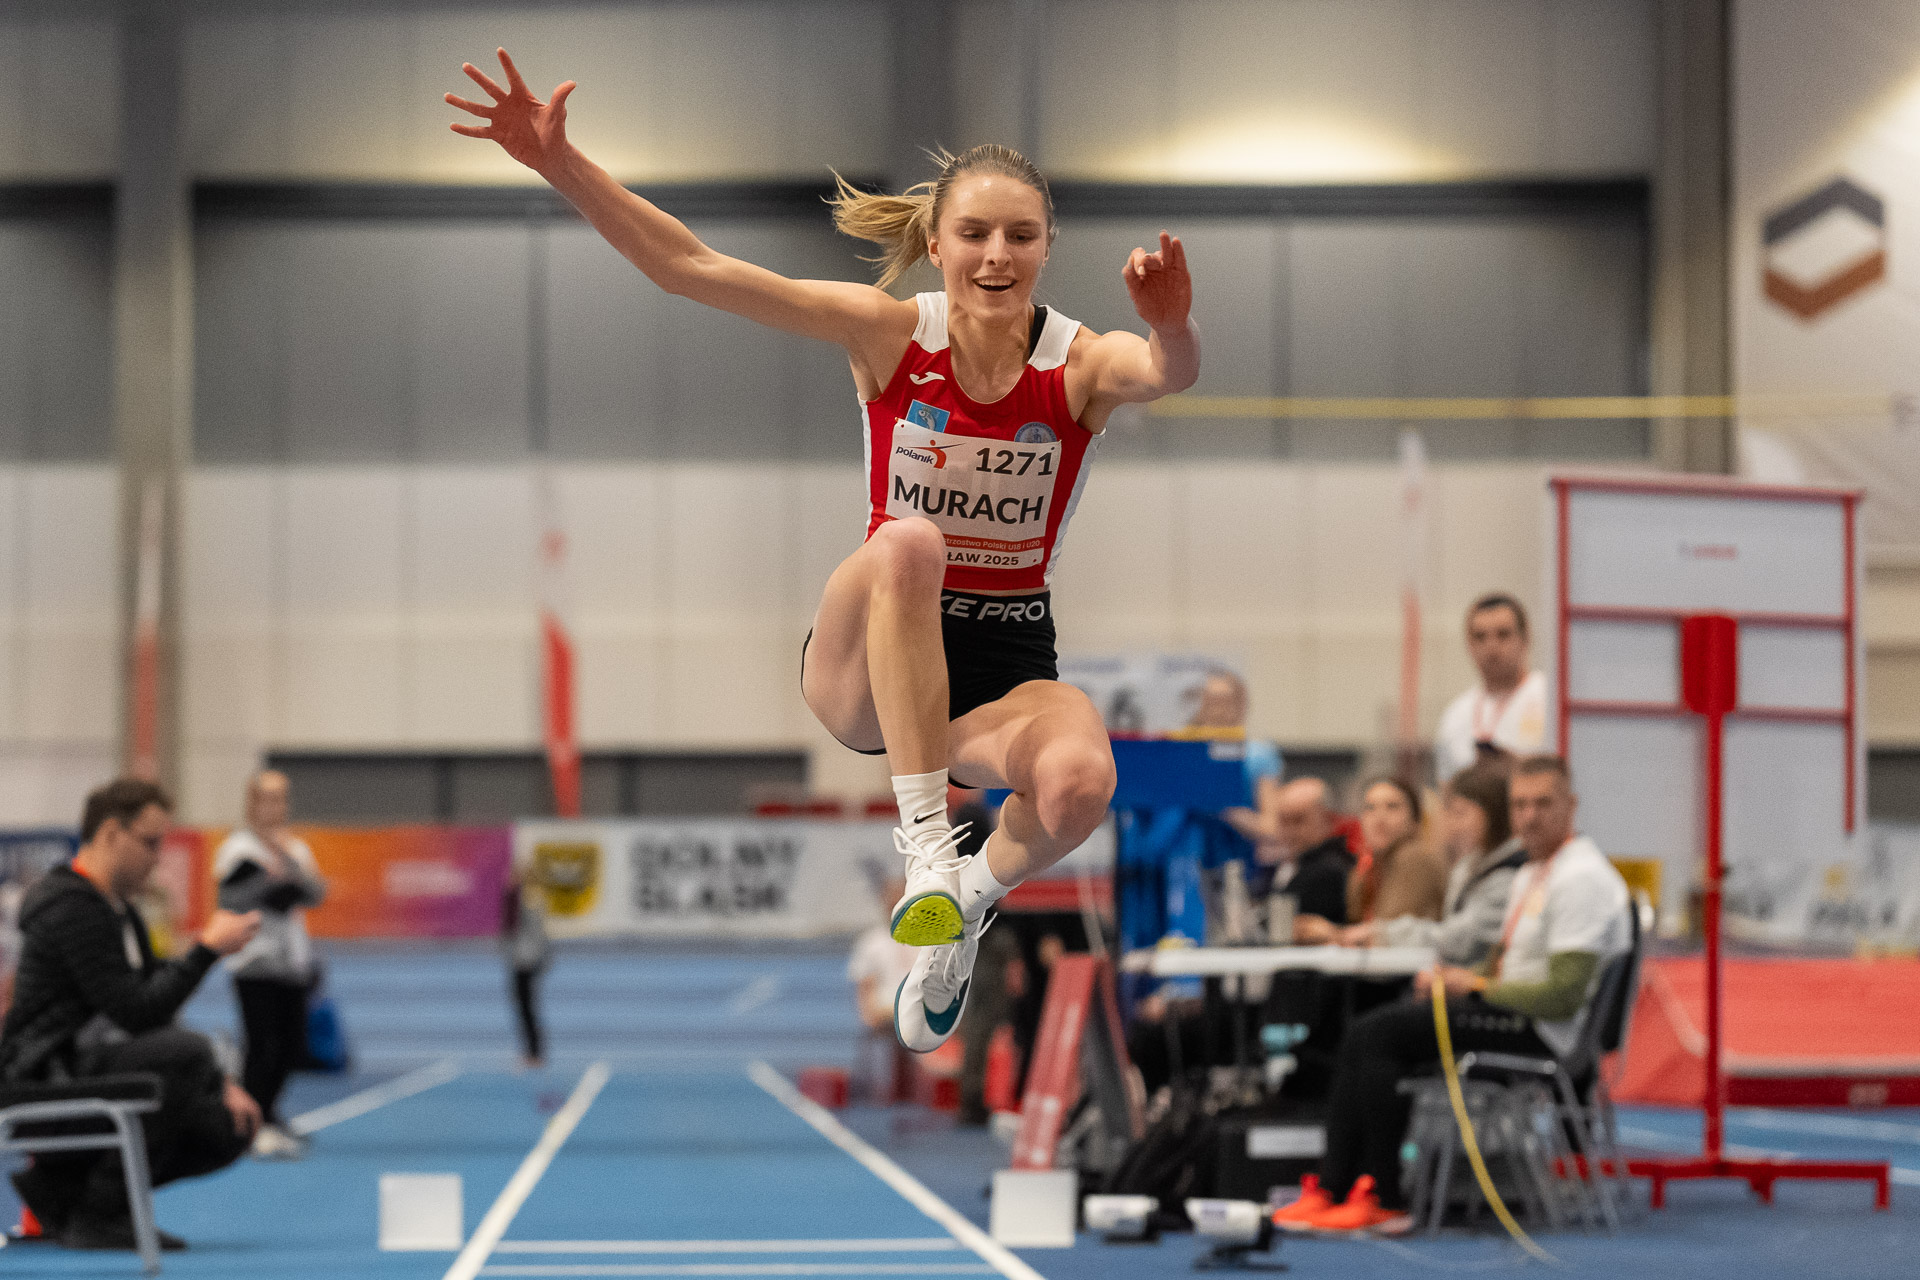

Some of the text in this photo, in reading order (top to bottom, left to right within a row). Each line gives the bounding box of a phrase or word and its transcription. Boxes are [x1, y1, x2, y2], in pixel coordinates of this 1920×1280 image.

[895, 446, 935, 465] polanik
[976, 448, 1053, 476] 1271
[894, 474, 1044, 524] MURACH
[945, 537, 981, 547] trzostwa
[983, 541, 1007, 551] Polski
[1007, 543, 1022, 552] U18
[1026, 539, 1041, 549] U20
[983, 554, 1020, 566] 2025
[977, 600, 1045, 622] PRO
